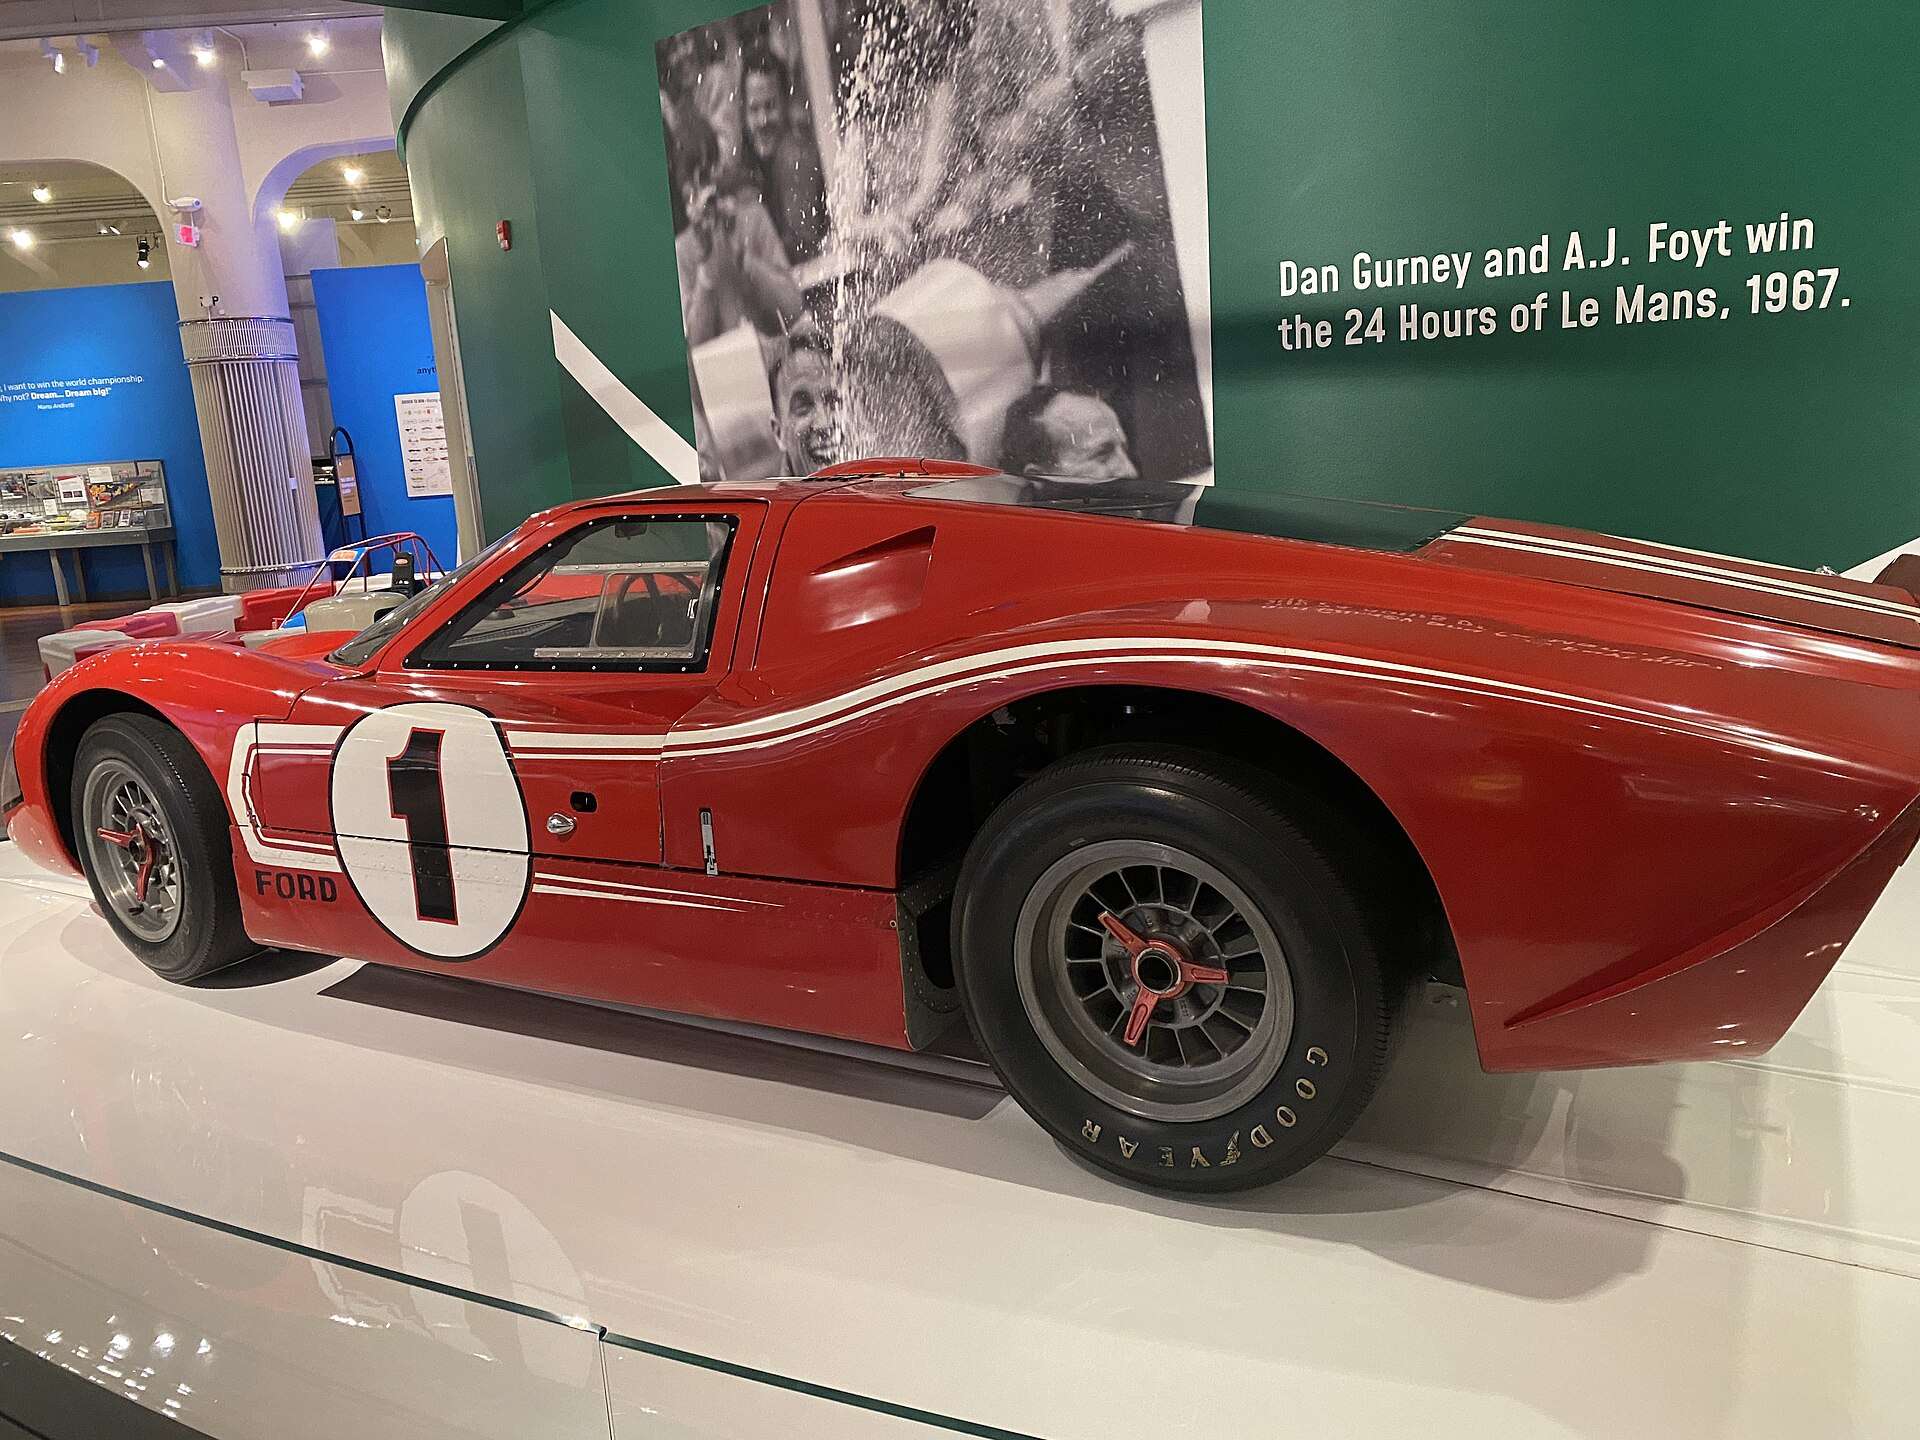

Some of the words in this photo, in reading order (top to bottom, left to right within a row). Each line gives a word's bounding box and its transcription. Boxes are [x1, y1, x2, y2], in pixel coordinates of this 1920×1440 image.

[1279, 260, 1339, 297] Dan
[1353, 251, 1473, 290] Gurney
[1484, 234, 1549, 278] and
[1562, 227, 1630, 271] A.J.
[1648, 220, 1733, 268] Foyt
[1745, 212, 1814, 254] win
[1277, 314, 1332, 350] the
[1344, 307, 1386, 346] 24
[1399, 303, 1497, 341] Hours
[1510, 292, 1548, 333] of
[1561, 290, 1599, 329] Le
[1615, 284, 1730, 325] Mans,
[1746, 267, 1850, 314] 1967.
[8, 382, 27, 391] want
[27, 382, 36, 390] to
[37, 381, 51, 389] win
[51, 379, 64, 388] the
[65, 377, 87, 387] world
[88, 375, 145, 386] championship.
[13, 392, 30, 401] not?
[65, 388, 93, 399] Dream
[385, 726, 459, 926] 1
[254, 869, 338, 903] FORD
